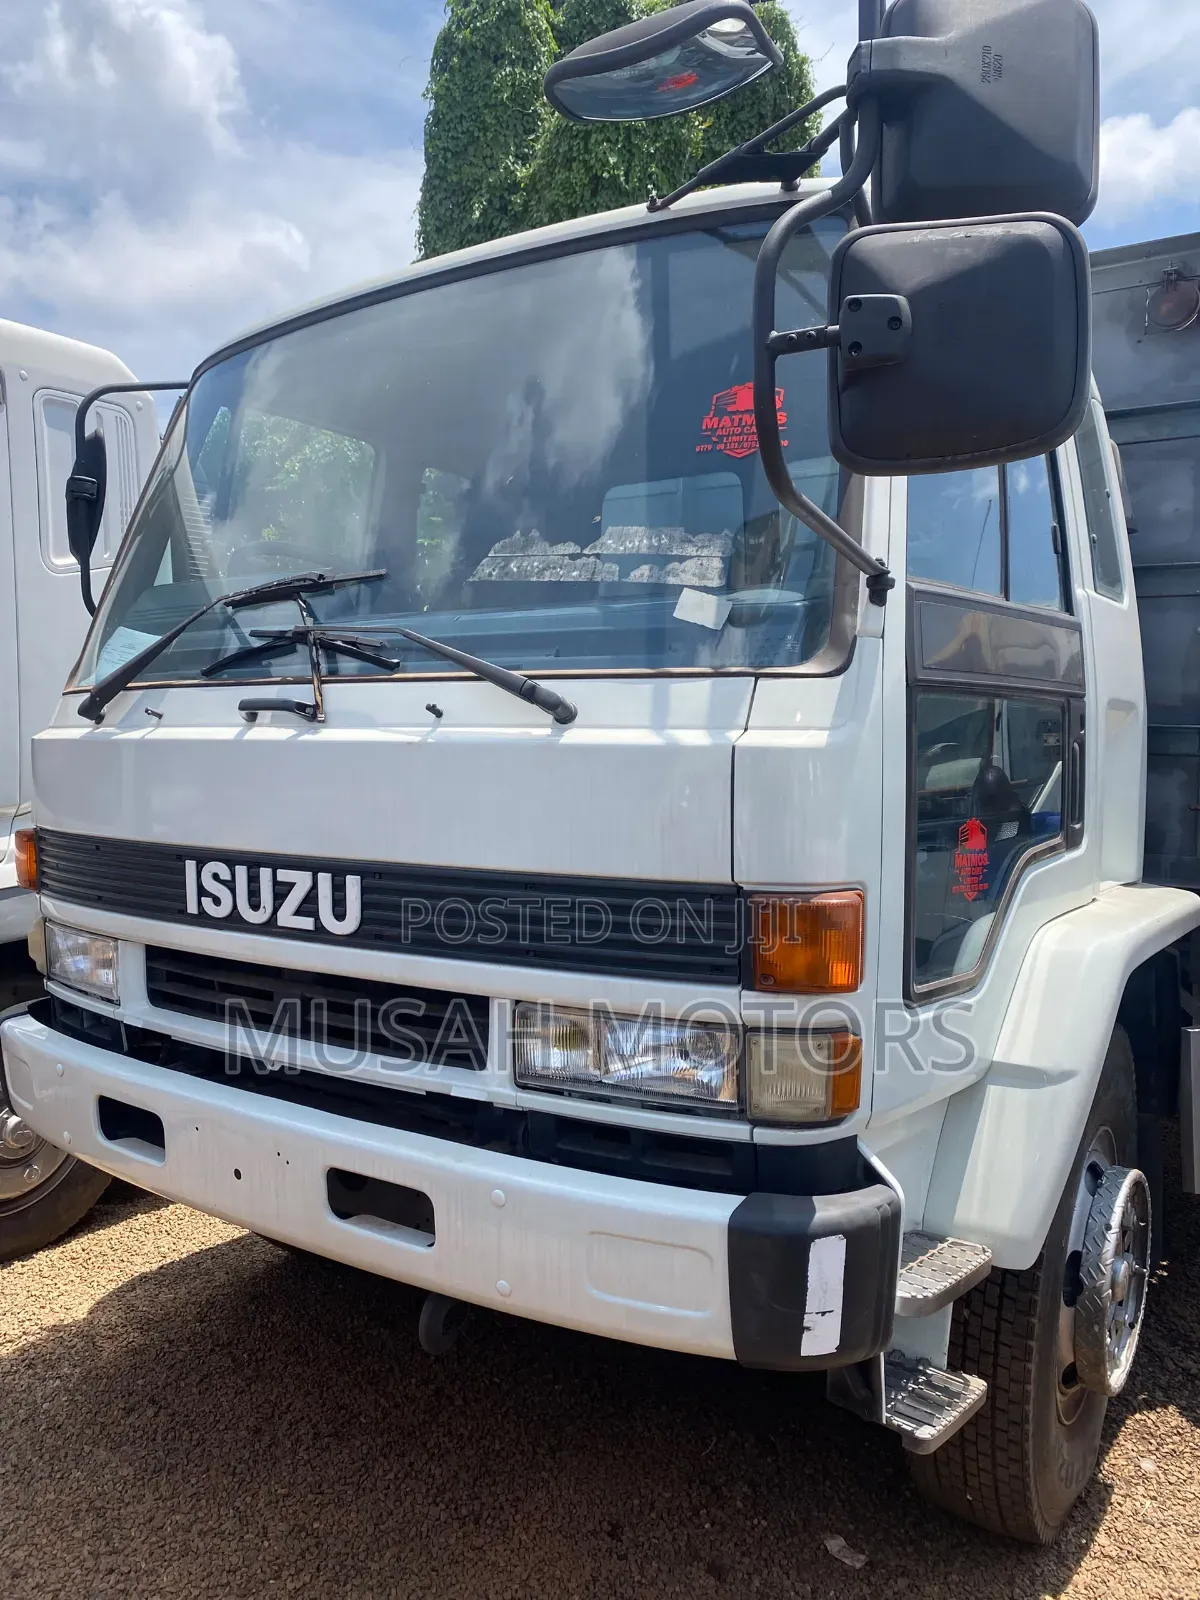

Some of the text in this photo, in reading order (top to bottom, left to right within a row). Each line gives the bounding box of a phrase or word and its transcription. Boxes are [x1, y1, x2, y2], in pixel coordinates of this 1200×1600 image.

[702, 412, 788, 430] MATMS
[716, 426, 742, 436] AUTO
[954, 853, 989, 868] MATMOS
[185, 859, 363, 936] ISUZU
